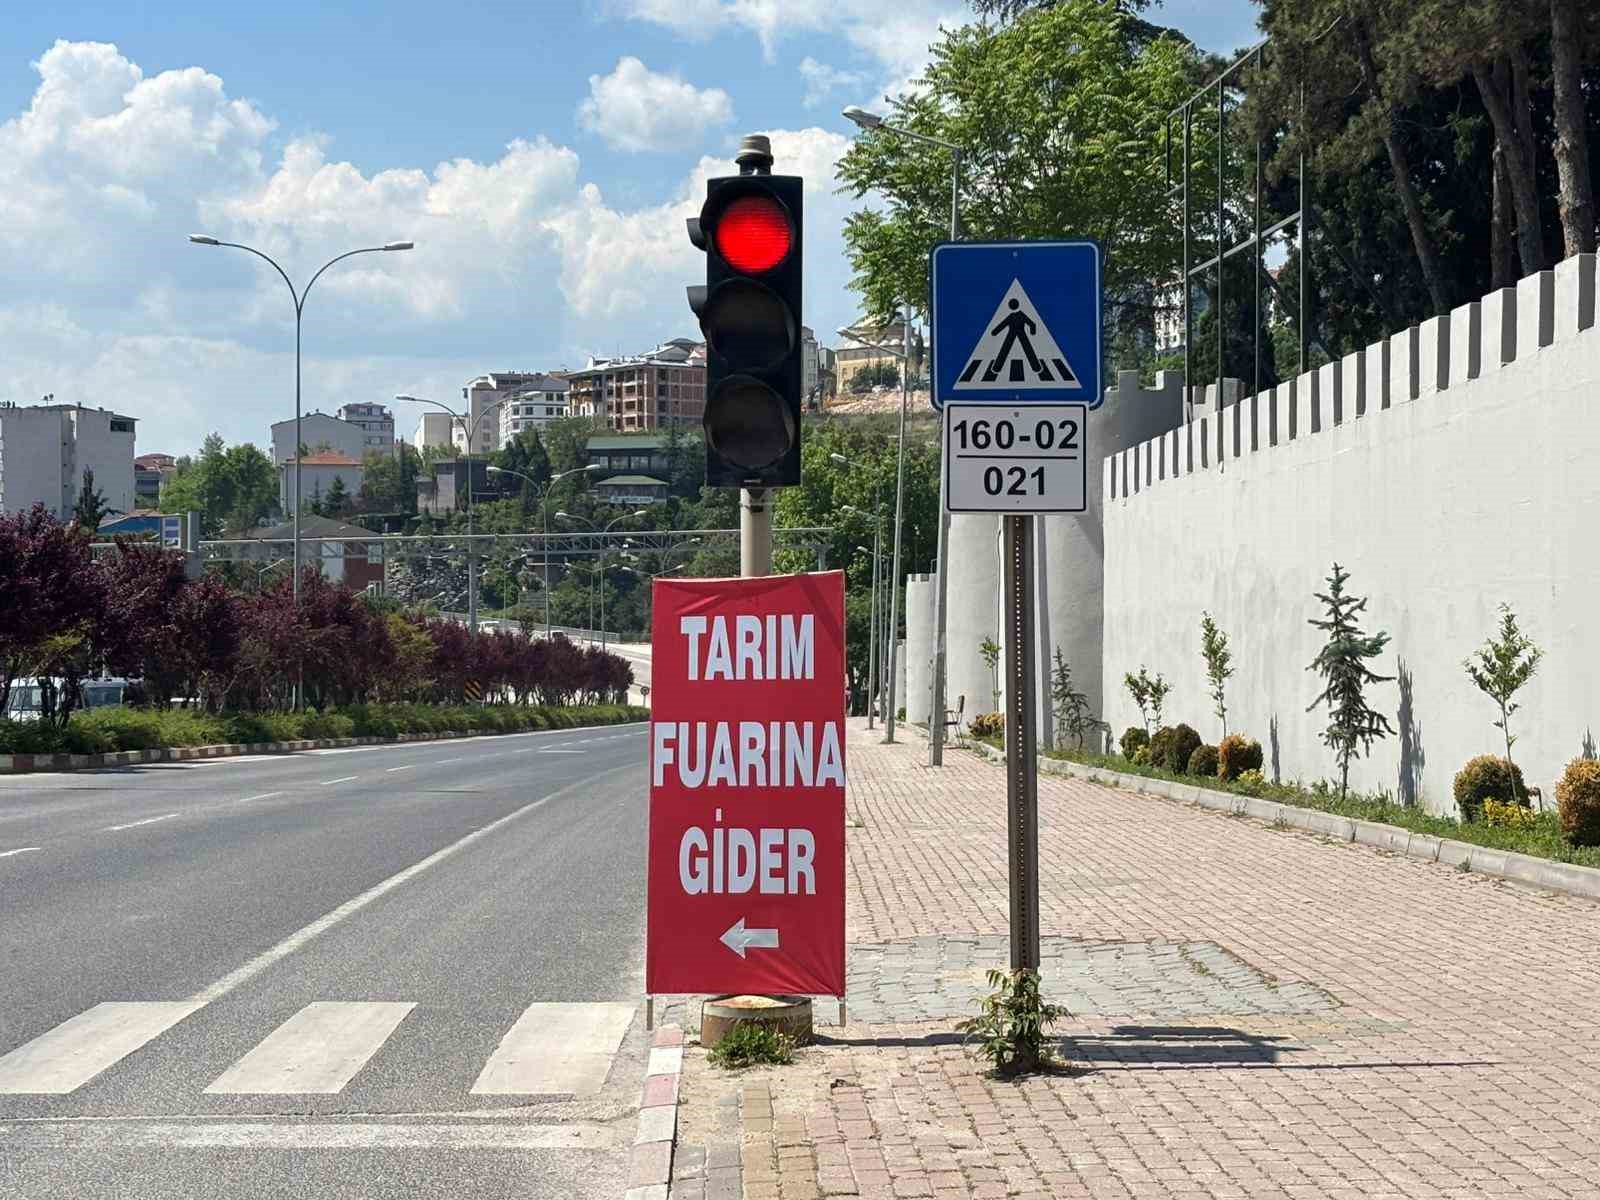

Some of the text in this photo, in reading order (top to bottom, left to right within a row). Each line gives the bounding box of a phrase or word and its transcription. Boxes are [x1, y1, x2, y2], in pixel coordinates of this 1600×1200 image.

[953, 419, 1079, 450] 160-02
[983, 465, 1045, 496] 021
[680, 614, 815, 681] TARIM
[653, 721, 846, 788] FUARINA
[679, 808, 816, 895] GİDER
